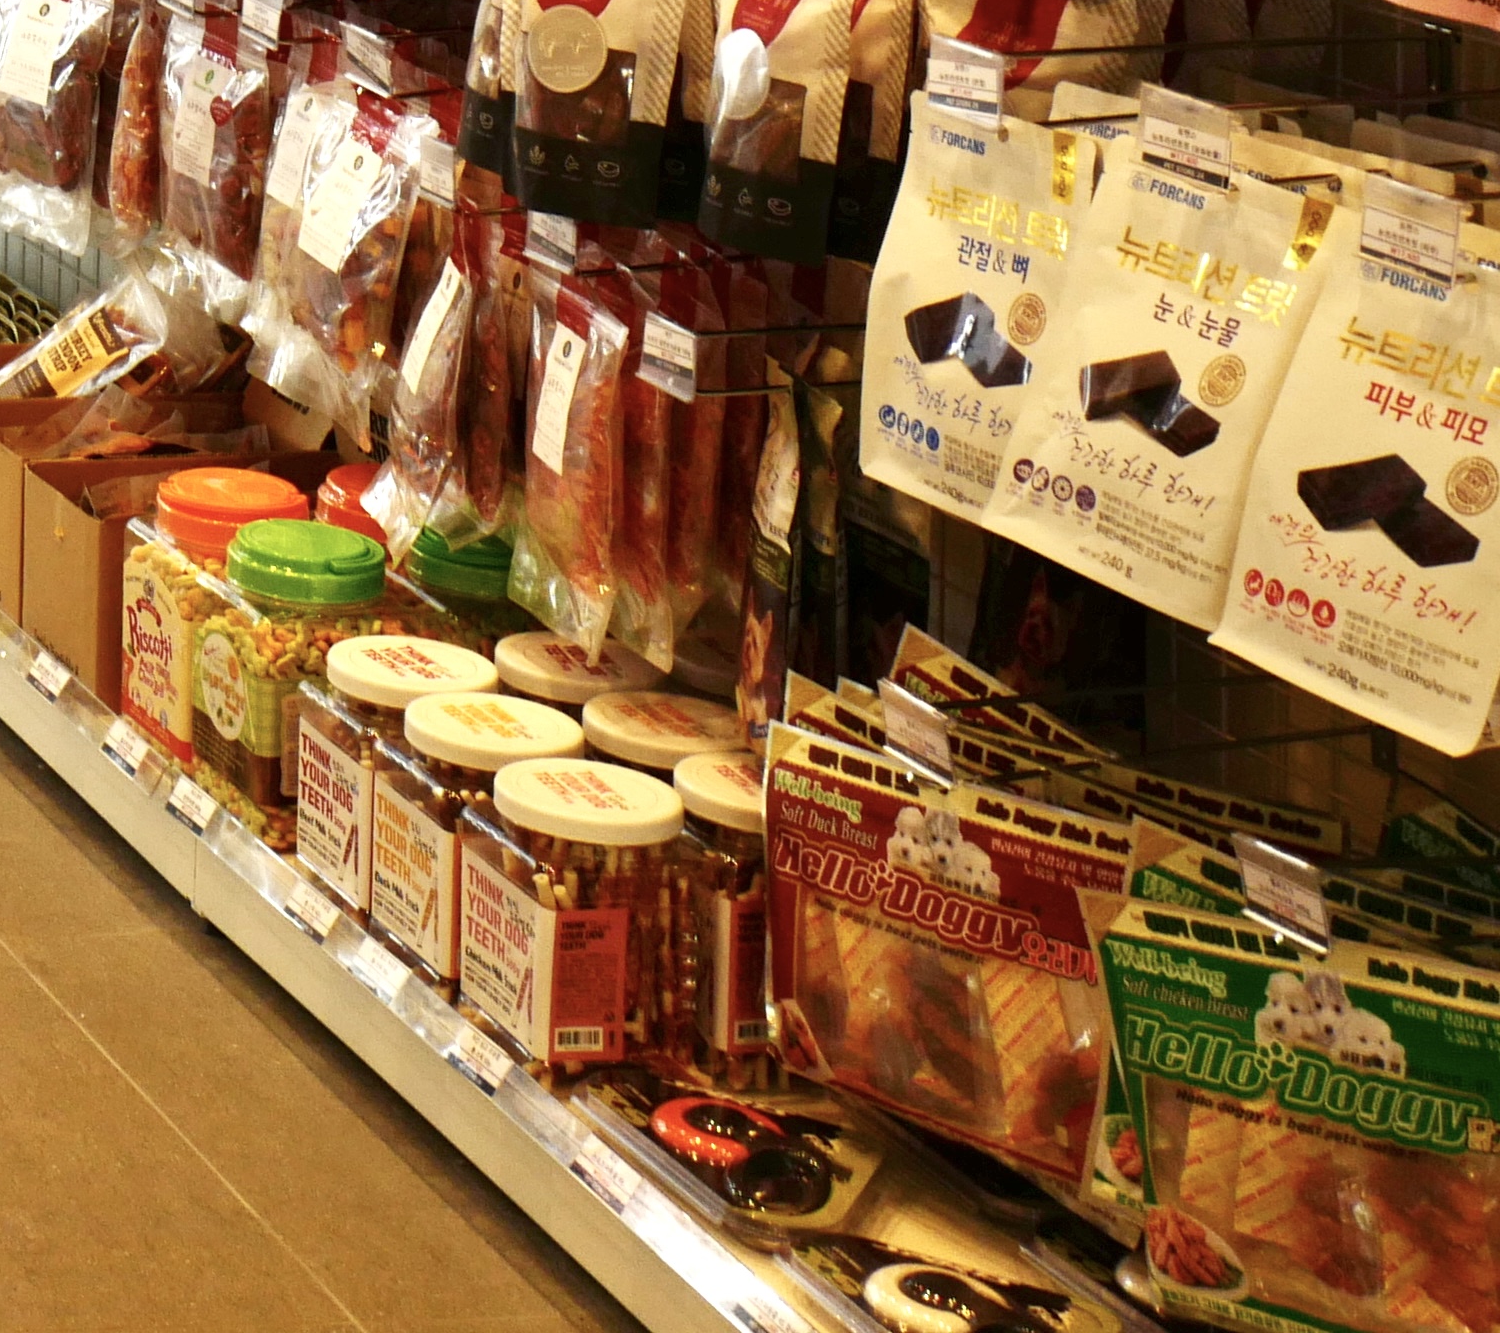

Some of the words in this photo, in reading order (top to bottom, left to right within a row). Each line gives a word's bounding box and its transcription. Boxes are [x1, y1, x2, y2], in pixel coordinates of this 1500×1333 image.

[941, 129, 986, 157] FORCANS
[926, 179, 1019, 240] 뉴트리션
[1149, 179, 1205, 210] FORCANS
[958, 236, 989, 271] 관절
[1012, 254, 1028, 281] 뼈
[1116, 227, 1238, 299] 뉴트리션
[1380, 267, 1447, 300] FORCANS
[1154, 293, 1173, 322] 눈
[1199, 307, 1239, 347] 눈물
[1339, 315, 1478, 394] 뉴트리션
[1365, 381, 1412, 424] 피부
[1446, 409, 1488, 445] 피모
[300, 734, 331, 772] THINK
[299, 781, 333, 821] TEETH
[774, 768, 863, 824] Well-being
[781, 800, 809, 826] Soft
[807, 807, 839, 836] Duck
[838, 819, 879, 851] Breast
[466, 864, 504, 908] THINK
[772, 831, 871, 897] Hello
[887, 879, 1029, 958] Doggy
[1108, 941, 1227, 997] Well-being
[1123, 1013, 1260, 1094] Hello
[1282, 1056, 1471, 1151] Doggy
